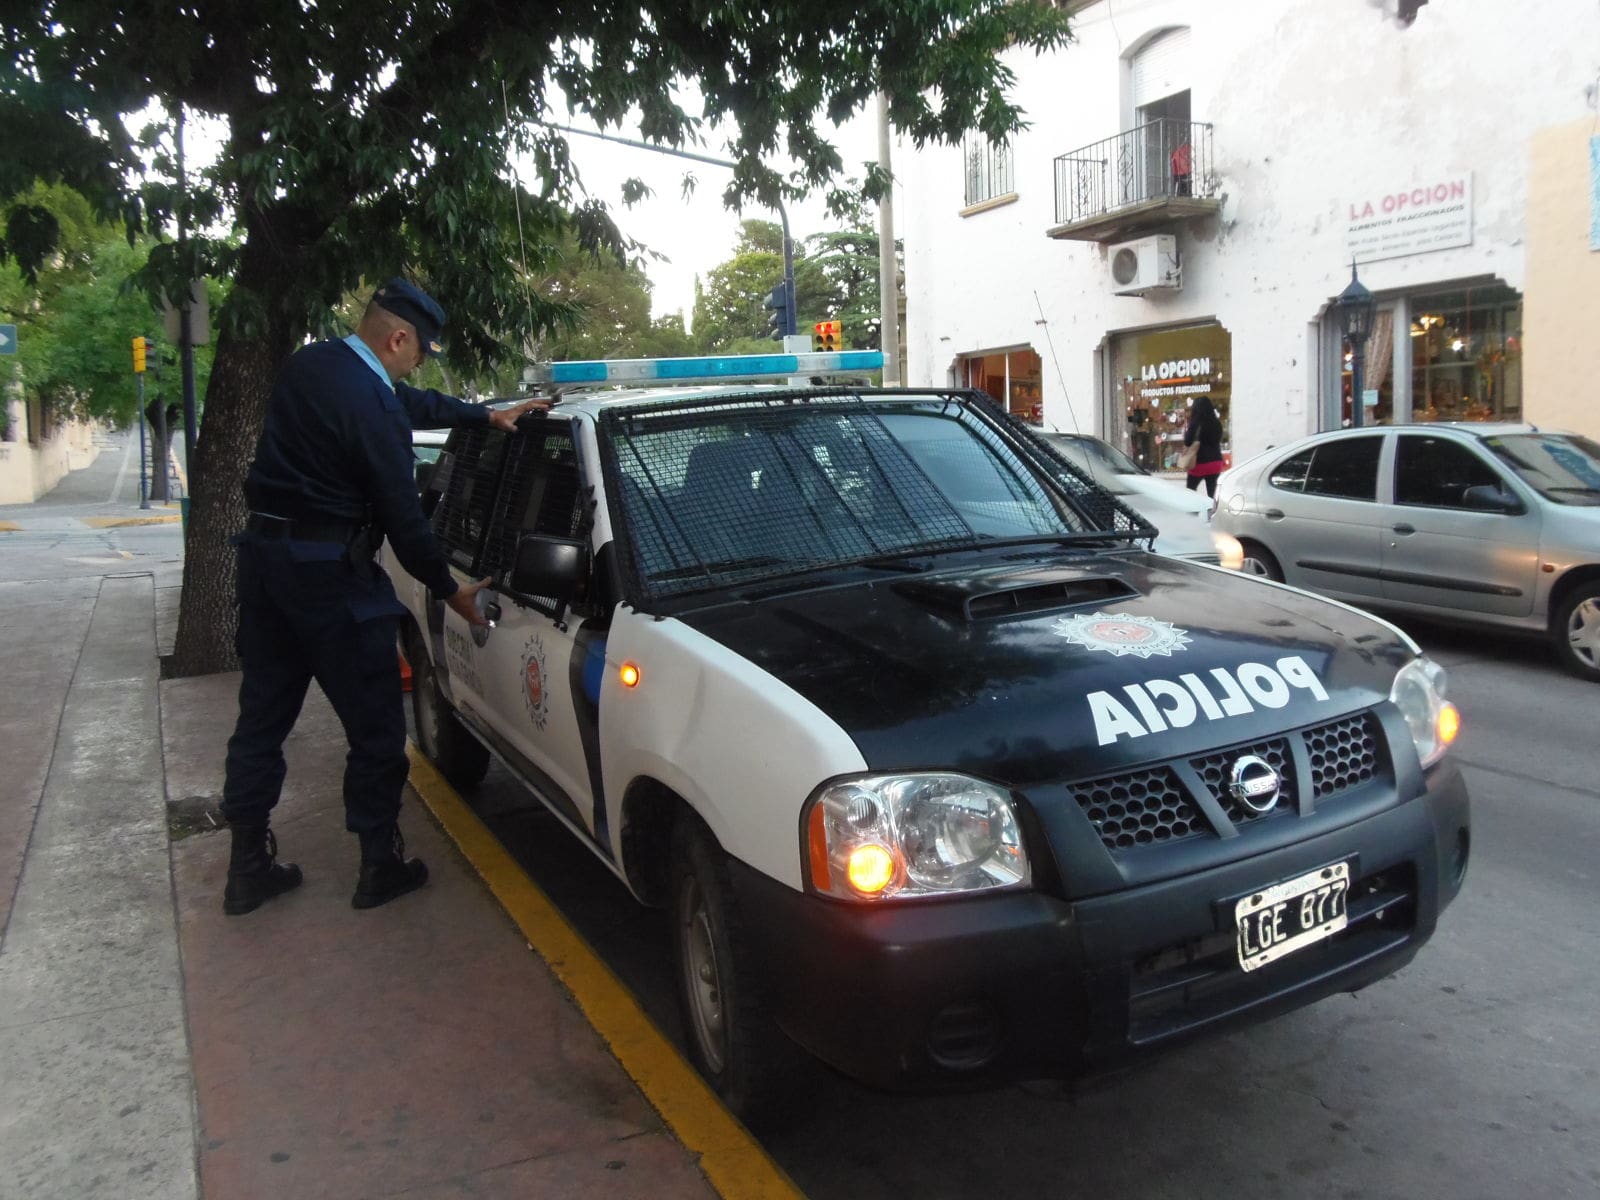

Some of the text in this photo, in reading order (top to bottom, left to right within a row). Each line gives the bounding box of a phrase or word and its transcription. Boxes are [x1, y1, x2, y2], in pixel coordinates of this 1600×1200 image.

[1350, 180, 1465, 221] LA OPCION
[1141, 357, 1210, 381] LA OPCION
[1141, 387, 1174, 397] PRODUCTOS
[1243, 902, 1288, 956] LGE
[1301, 880, 1346, 929] 877
